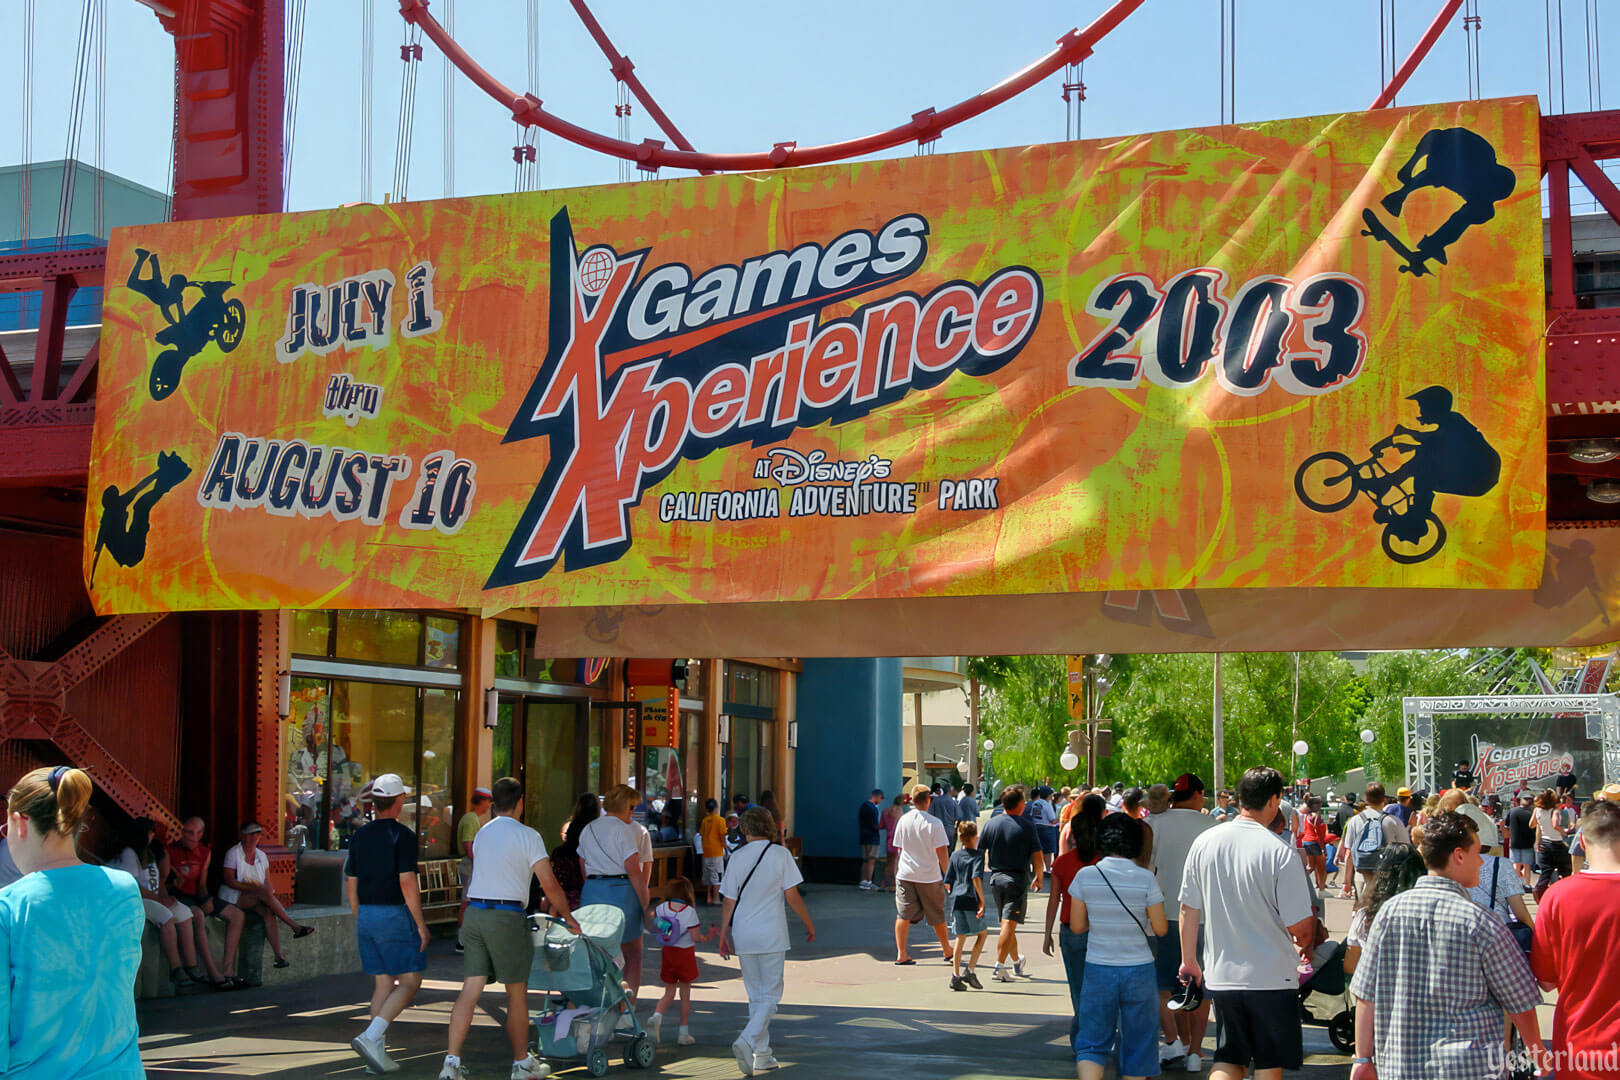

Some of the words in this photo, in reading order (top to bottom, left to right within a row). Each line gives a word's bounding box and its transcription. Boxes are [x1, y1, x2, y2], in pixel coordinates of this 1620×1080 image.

[281, 275, 394, 357] JULY
[404, 264, 438, 335] 1
[626, 214, 926, 341] Games
[1070, 270, 1365, 393] 2003
[324, 374, 382, 418] thru
[513, 268, 1041, 568] Xperience
[200, 434, 402, 522] AUGUST
[407, 453, 474, 530] 10
[659, 489, 779, 522] CALIFORNIA
[938, 478, 1000, 511] PARK
[754, 459, 771, 479] AT
[768, 449, 892, 489] Disney's
